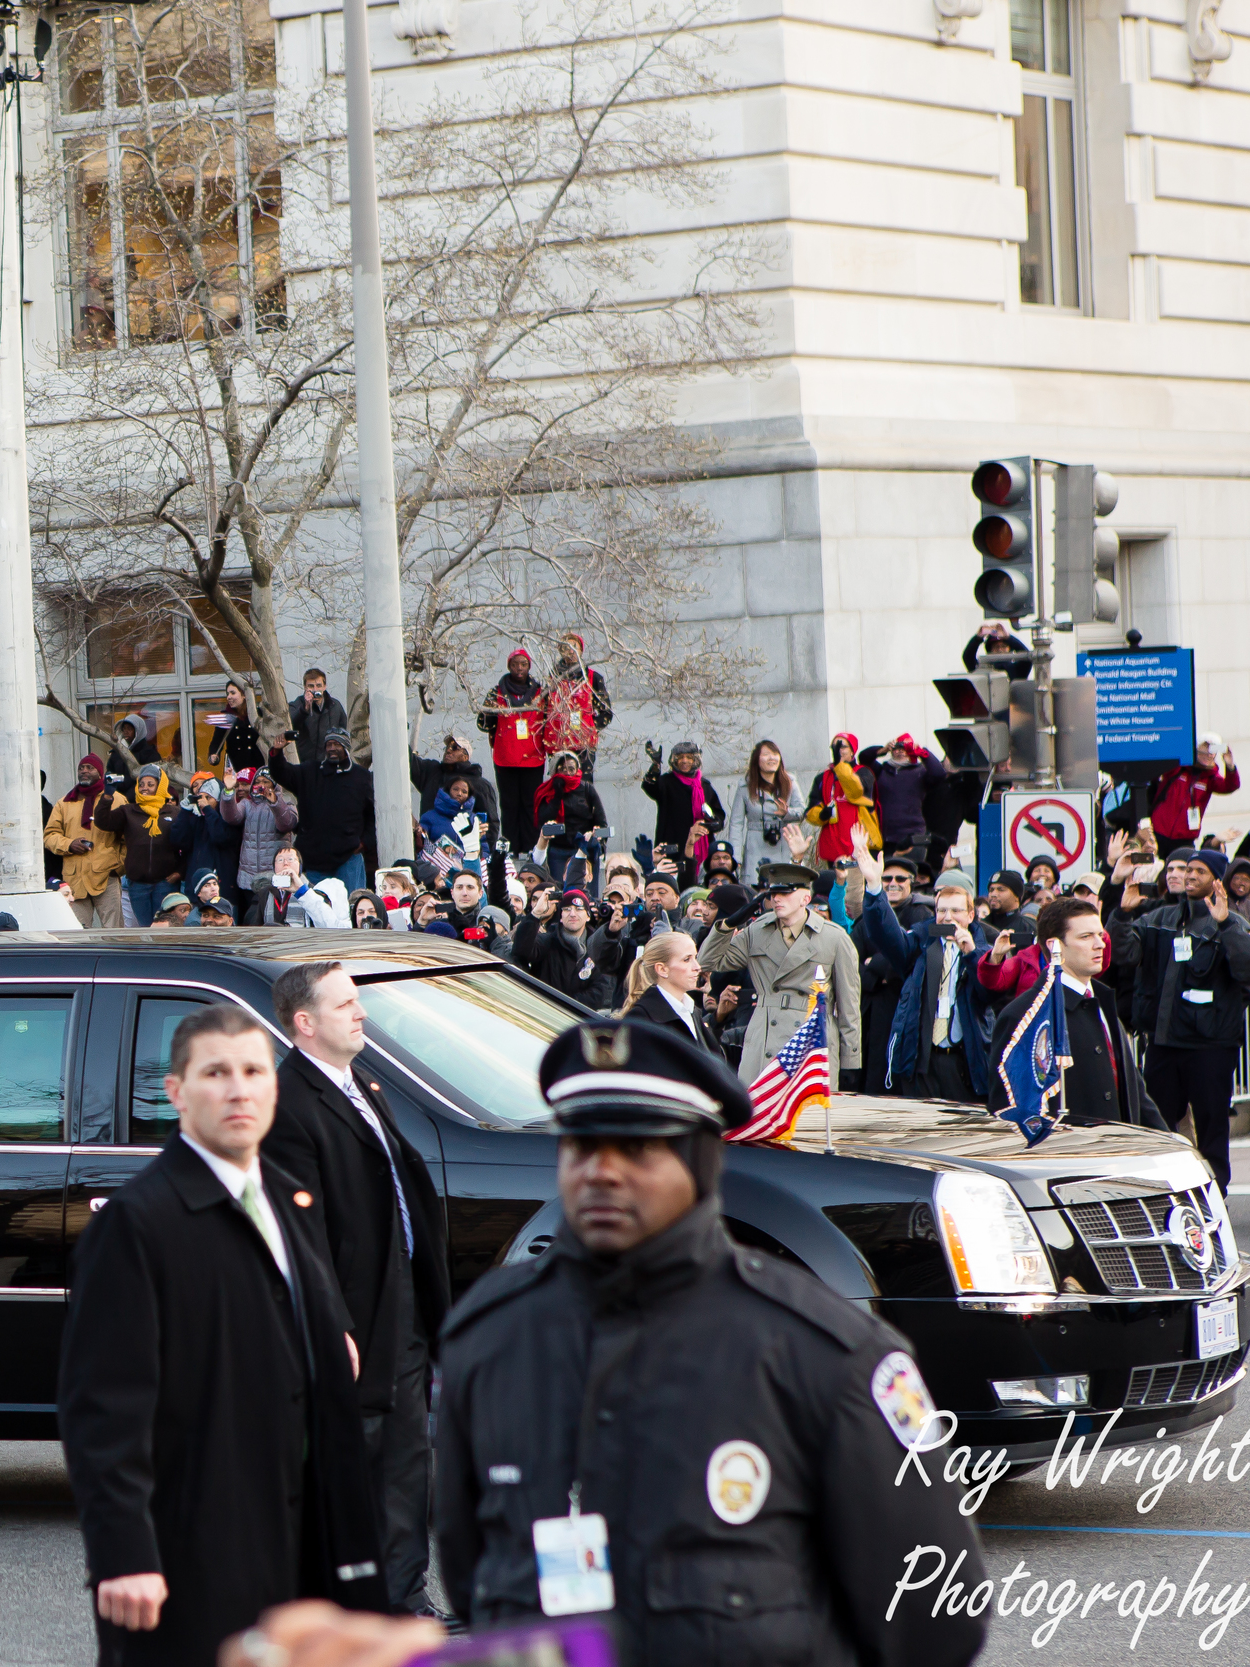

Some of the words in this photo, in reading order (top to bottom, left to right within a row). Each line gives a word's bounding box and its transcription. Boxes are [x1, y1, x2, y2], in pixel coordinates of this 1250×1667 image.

[1094, 657, 1124, 667] National
[1125, 656, 1160, 667] Aquarium
[1094, 669, 1119, 678] Ronald
[1120, 668, 1146, 679] Reagan
[1147, 667, 1178, 678] Building
[1095, 681, 1117, 691] Visitor
[1118, 680, 1160, 690] Information
[1109, 692, 1139, 702] National
[1140, 691, 1156, 701] Mall
[1140, 704, 1174, 712] Museums
[1110, 717, 1130, 726] White
[1131, 716, 1154, 725] House
[1105, 733, 1130, 743] Federal
[1132, 732, 1160, 743] Triangle
